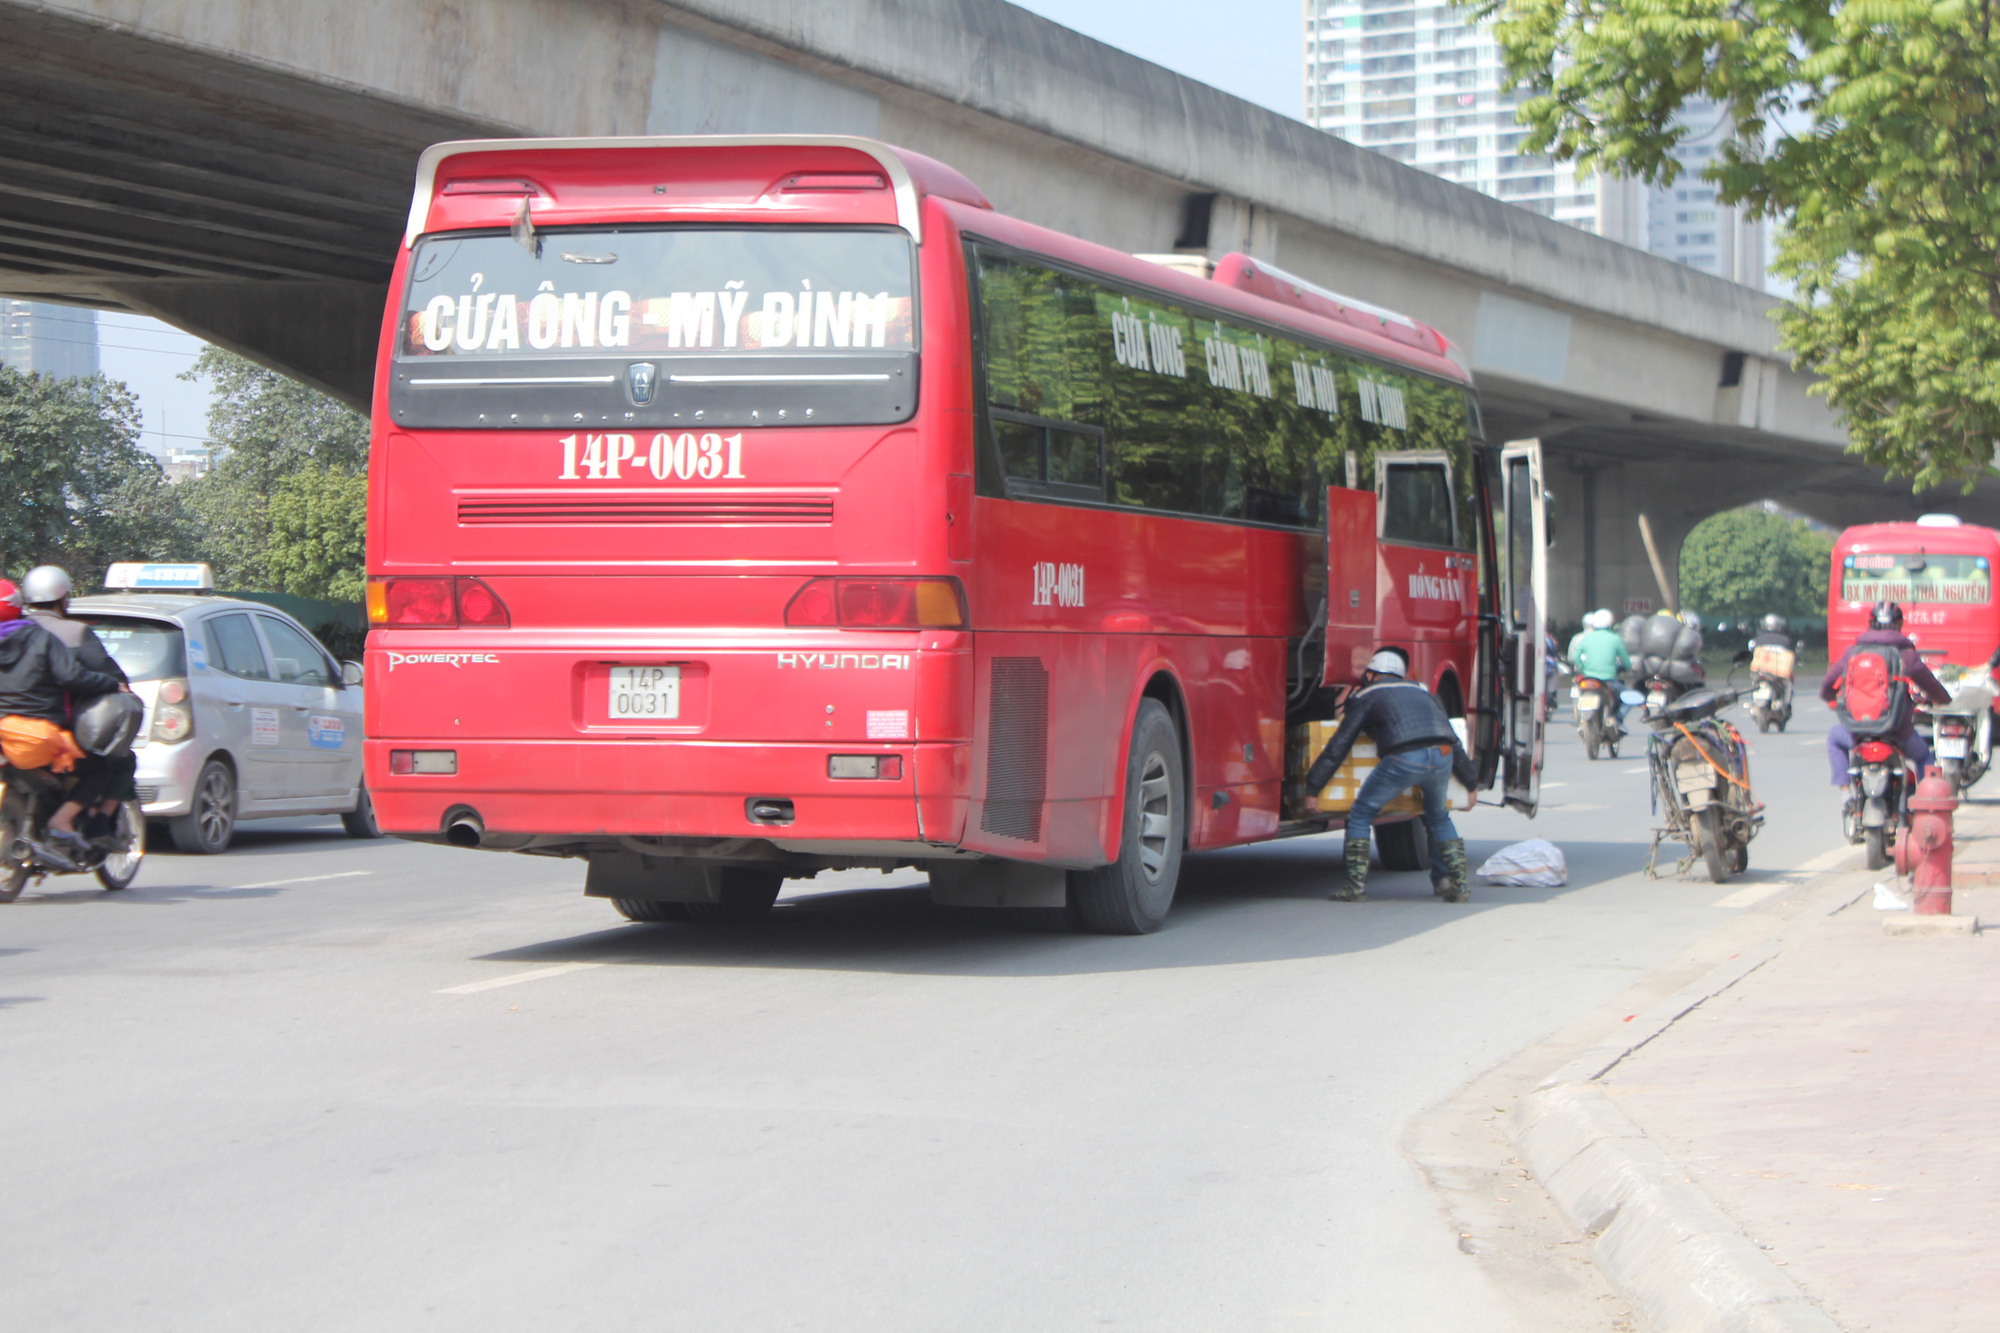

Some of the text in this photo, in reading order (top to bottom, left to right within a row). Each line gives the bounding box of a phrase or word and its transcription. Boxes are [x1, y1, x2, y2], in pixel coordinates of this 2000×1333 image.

[423, 272, 519, 351] CỬA
[528, 280, 631, 350] ÔNG
[667, 280, 748, 348] MỸ
[760, 278, 889, 348] ĐÌNH
[1149, 311, 1186, 378] ÔNG
[558, 432, 746, 480] 14P-0031
[1032, 560, 1085, 608] 14P-0031
[386, 651, 500, 673] POWERTEC
[777, 653, 910, 670] HYUNDAI
[628, 668, 664, 691] 14P
[617, 692, 668, 714] 0031
